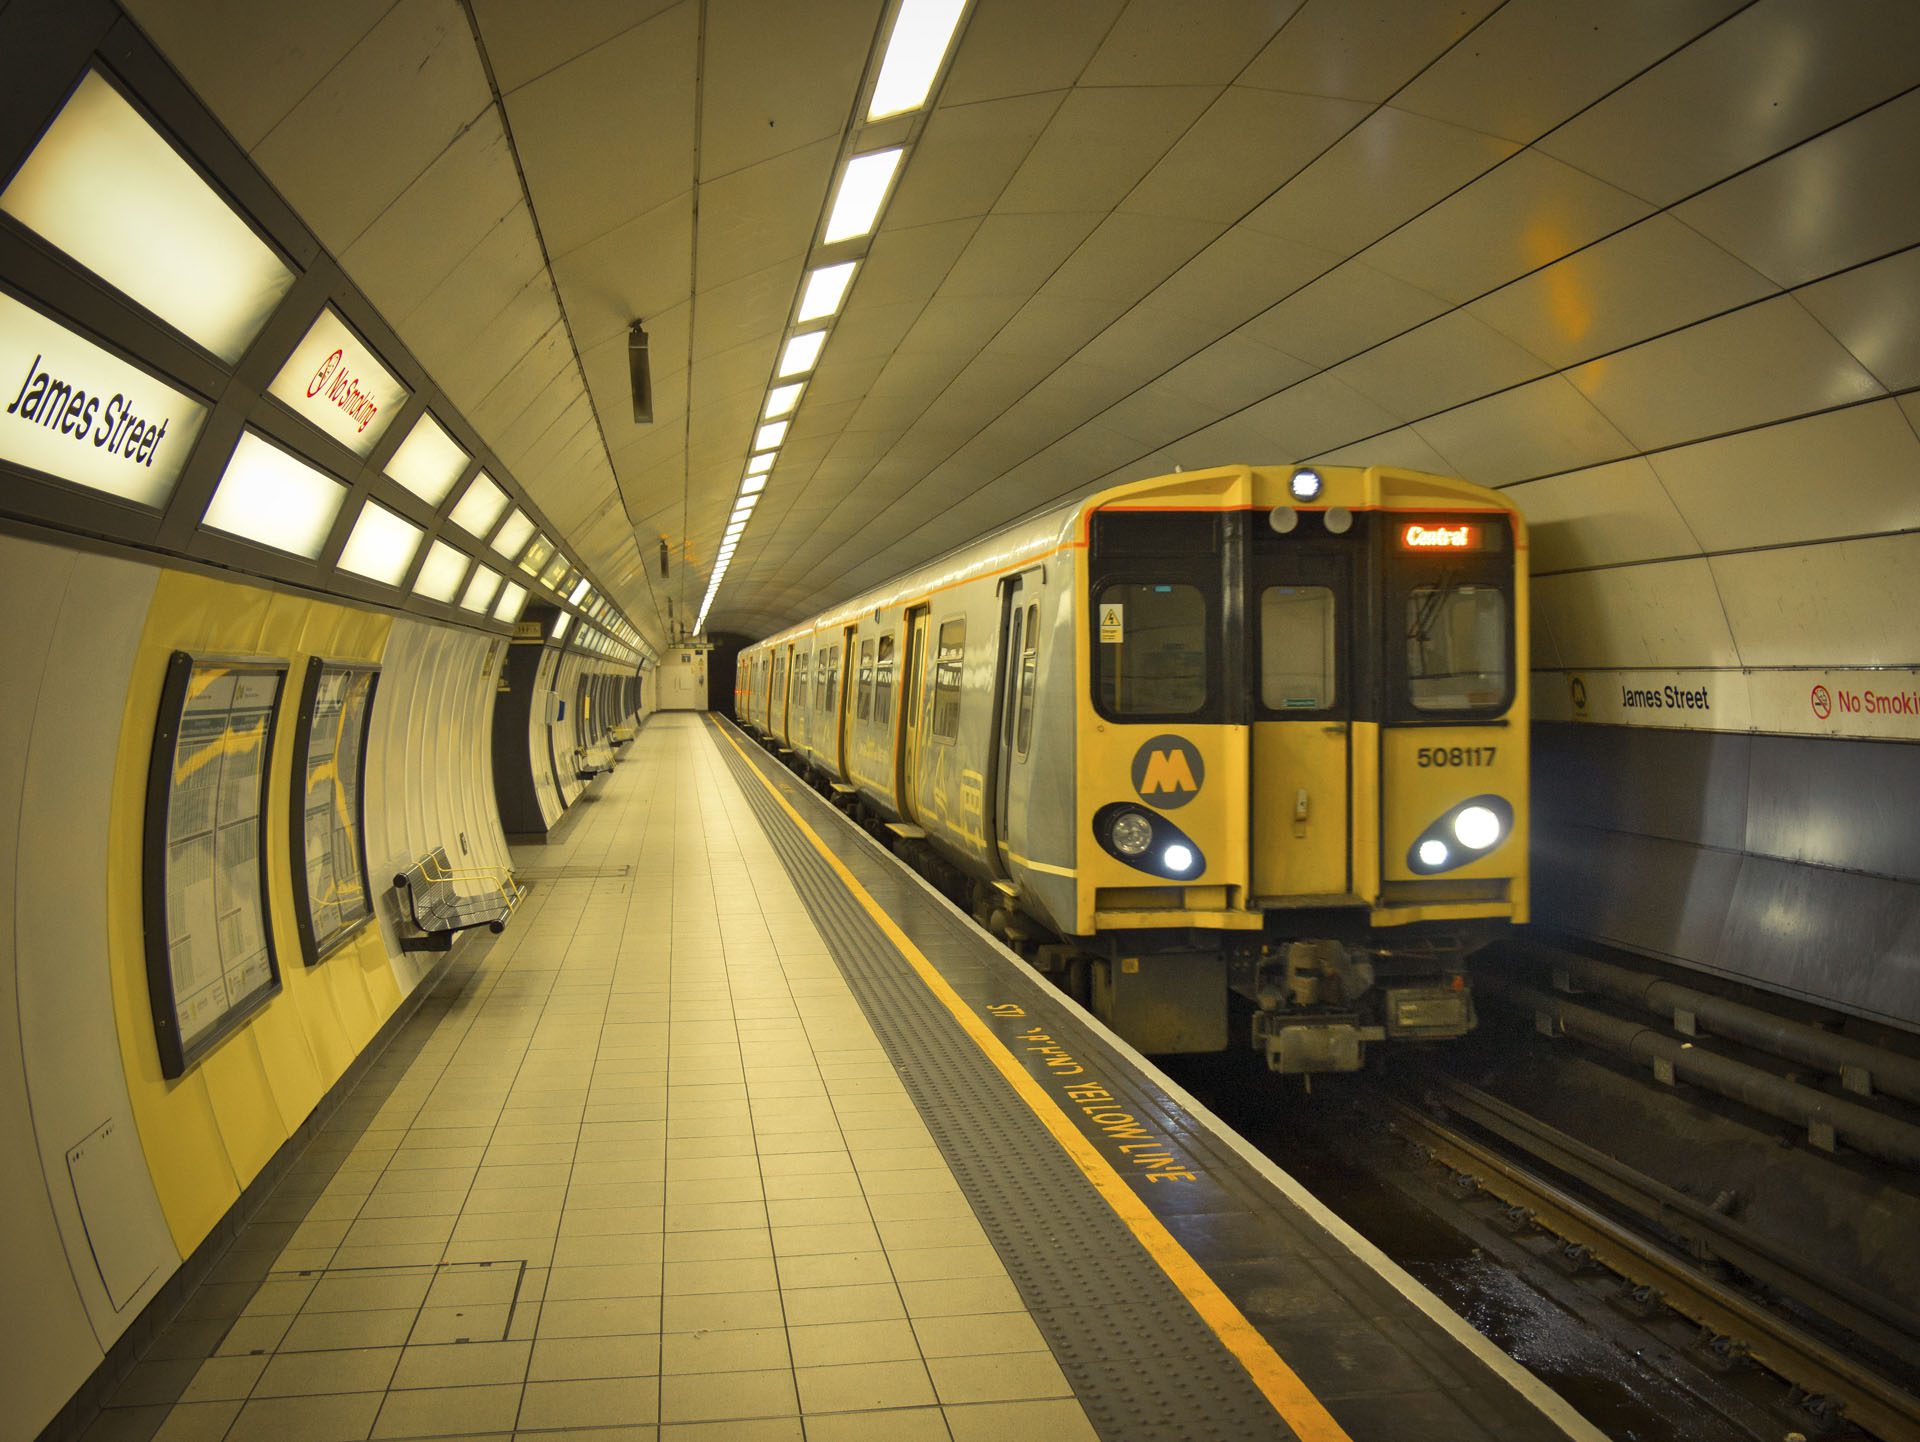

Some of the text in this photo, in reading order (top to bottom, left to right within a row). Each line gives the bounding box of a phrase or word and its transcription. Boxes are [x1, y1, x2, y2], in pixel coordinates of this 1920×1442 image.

[7, 354, 169, 468] James Street
[325, 367, 378, 433] No Smoking
[1622, 685, 1710, 710] James Street
[1838, 690, 1920, 715] No Smoki
[1417, 747, 1497, 768] 508117
[1063, 1081, 1154, 1139] YELLOW
[1119, 1143, 1197, 1183] LINE
